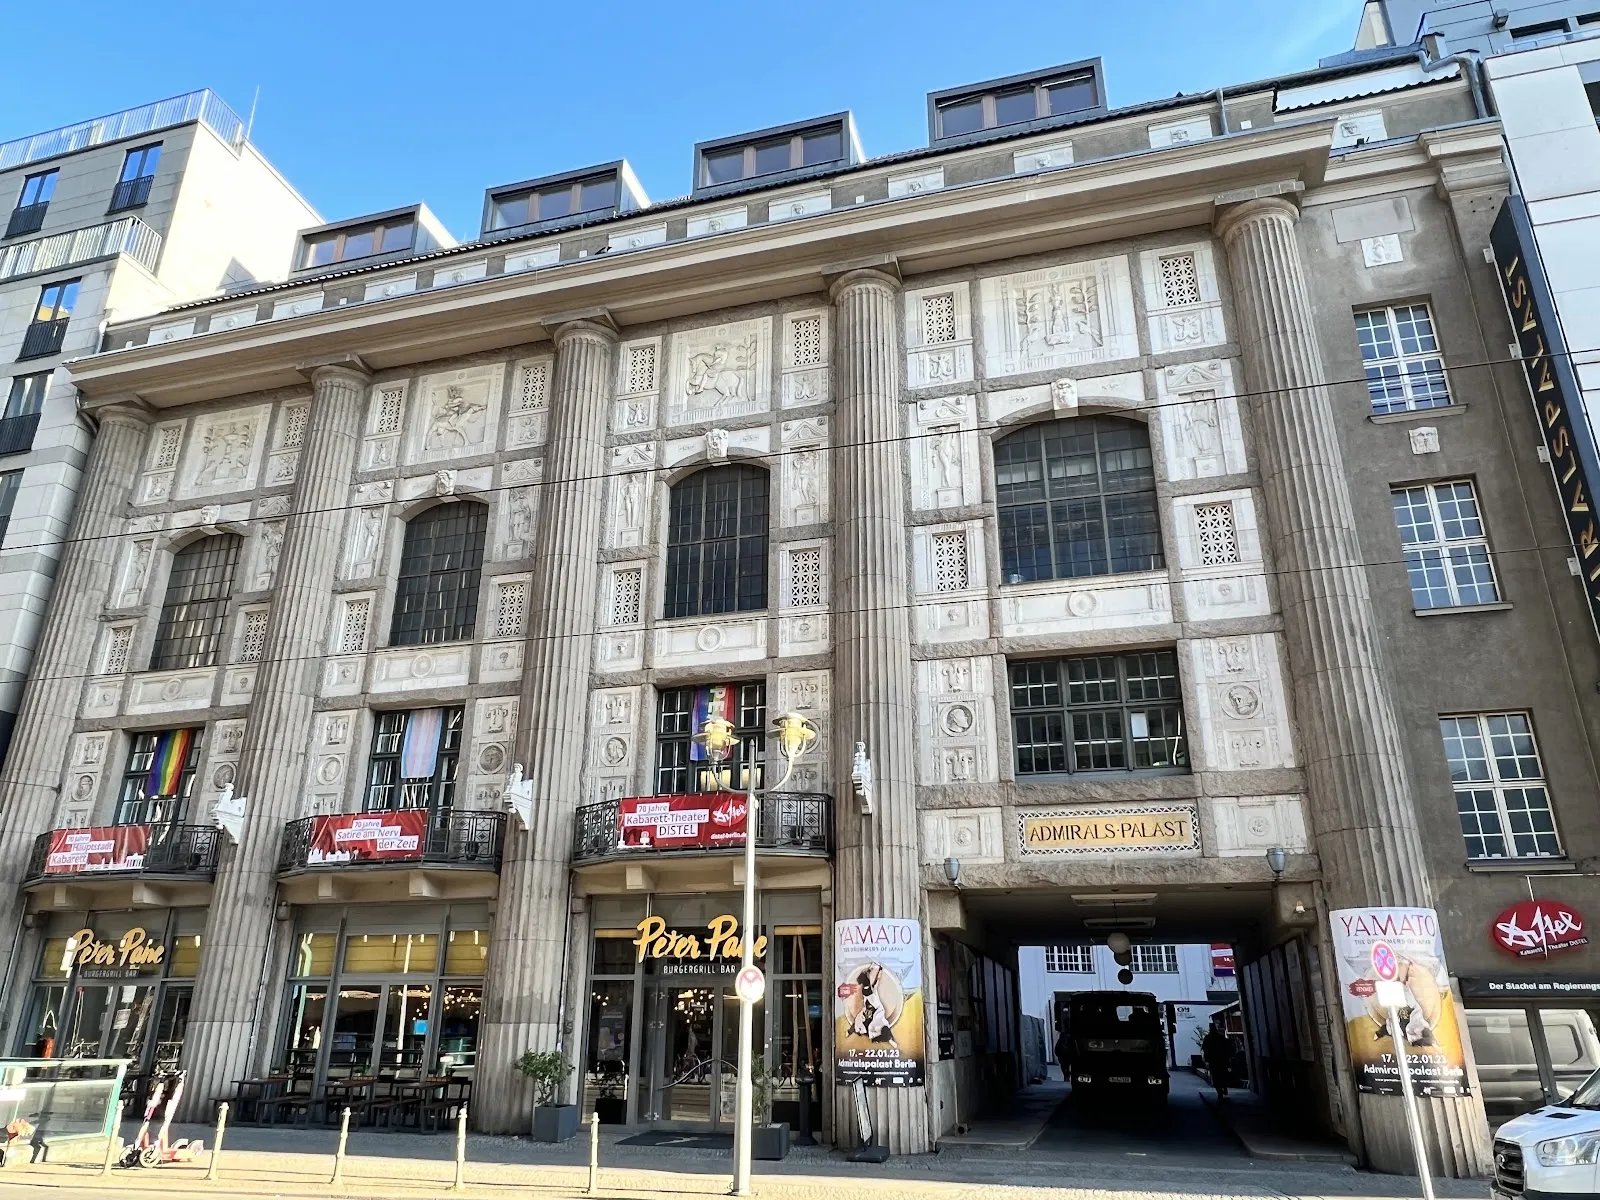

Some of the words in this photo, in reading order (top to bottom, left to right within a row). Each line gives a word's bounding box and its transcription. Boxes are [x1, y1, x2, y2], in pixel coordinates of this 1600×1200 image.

[1505, 256, 1600, 603] IRALSPALAST
[639, 805, 647, 813] 70
[648, 804, 668, 813] Jahre
[626, 813, 707, 825] Kabarett-Theater
[337, 830, 361, 840] Satire
[363, 830, 375, 838] am
[378, 828, 399, 838] Nerv
[659, 824, 696, 837] DISTEL
[73, 842, 113, 853] Hauptstadt
[378, 840, 395, 849] der
[397, 839, 417, 849] Zeit
[51, 854, 87, 865] Kabarett
[1340, 913, 1436, 937] YAMATO
[633, 915, 701, 964] Peter
[838, 924, 912, 946] YAMATO
[70, 928, 116, 967] Peter
[119, 927, 165, 967] Pane
[663, 964, 716, 974] BURGERGRILL
[720, 964, 736, 974] BAR
[1489, 982, 1504, 990] Der
[1505, 982, 1537, 990] Stachel
[864, 1048, 900, 1058] 22.01.23
[1381, 1053, 1395, 1063] 17.
[838, 1058, 893, 1070] Admiralspalast
[894, 1059, 917, 1069] Berlin
